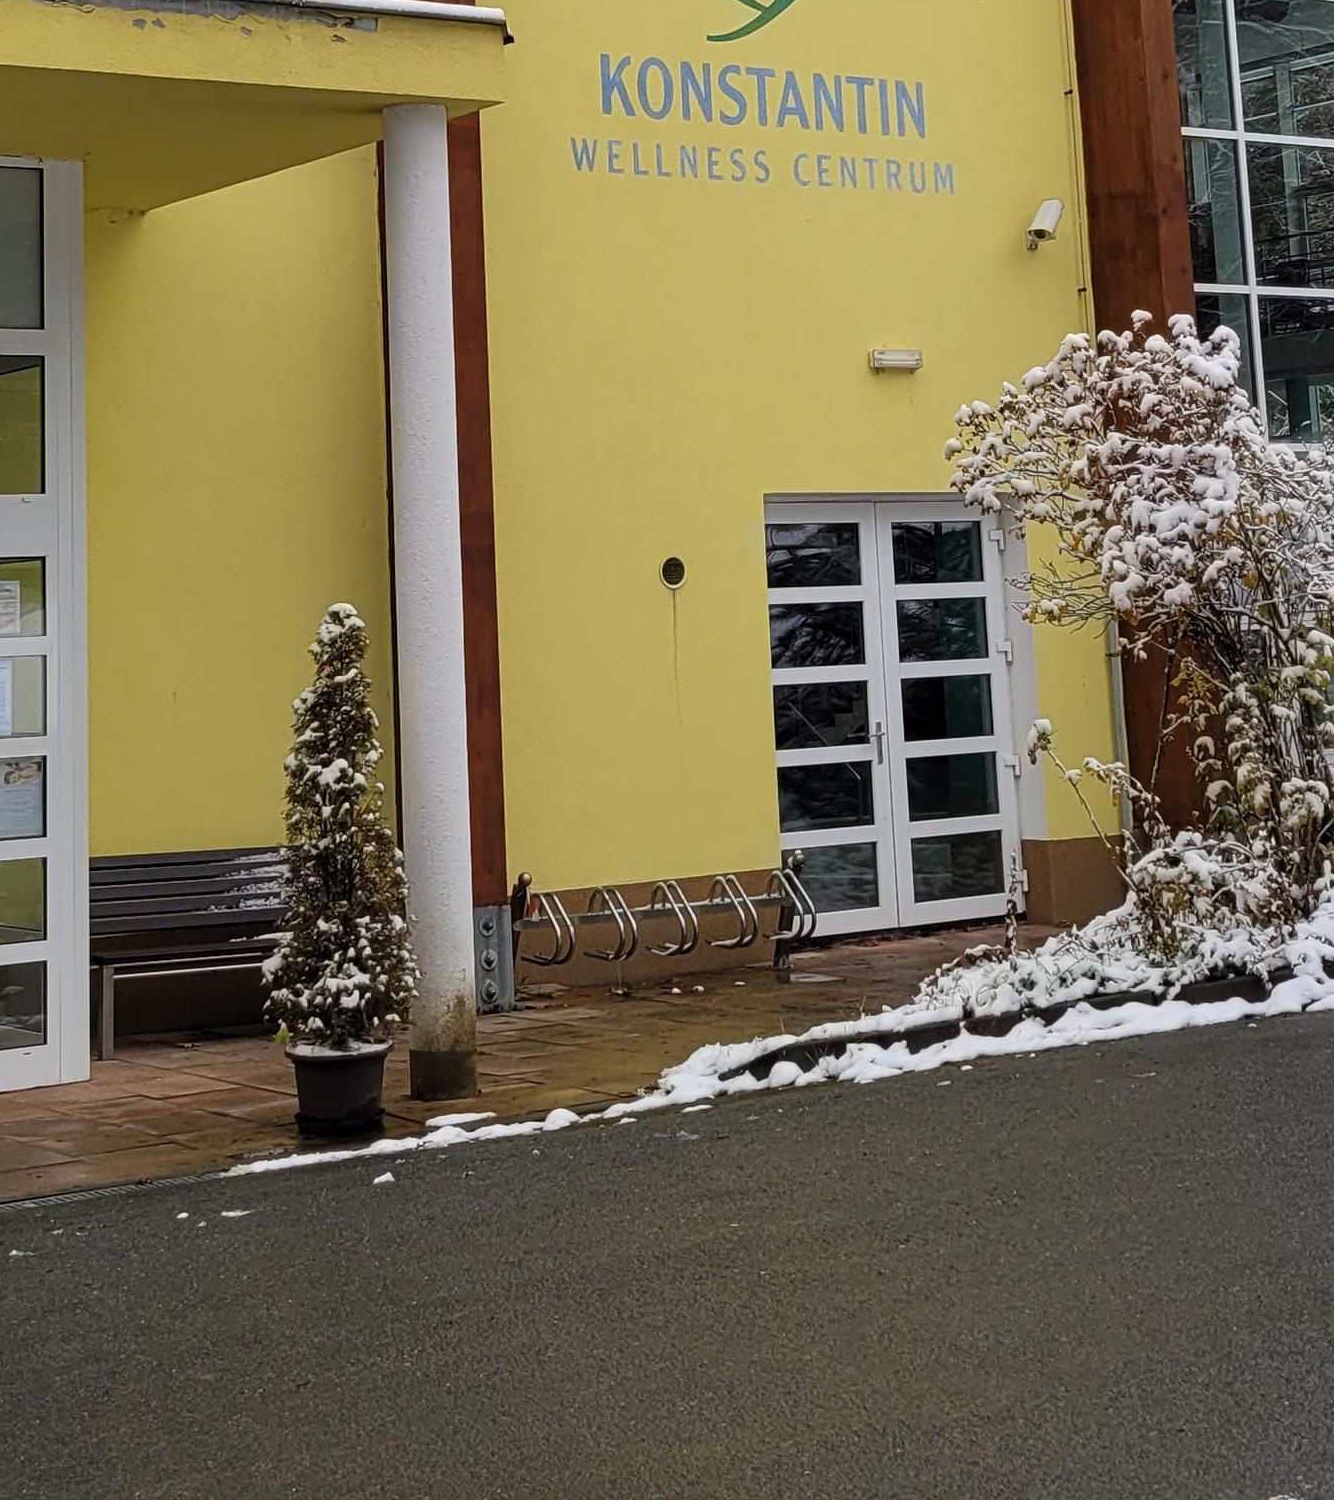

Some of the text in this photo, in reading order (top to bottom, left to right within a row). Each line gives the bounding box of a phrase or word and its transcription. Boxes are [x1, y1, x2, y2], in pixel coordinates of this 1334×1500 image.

[599, 53, 926, 139] KONSTANTIN
[570, 136, 955, 195] WELLNESS CENTRUM
